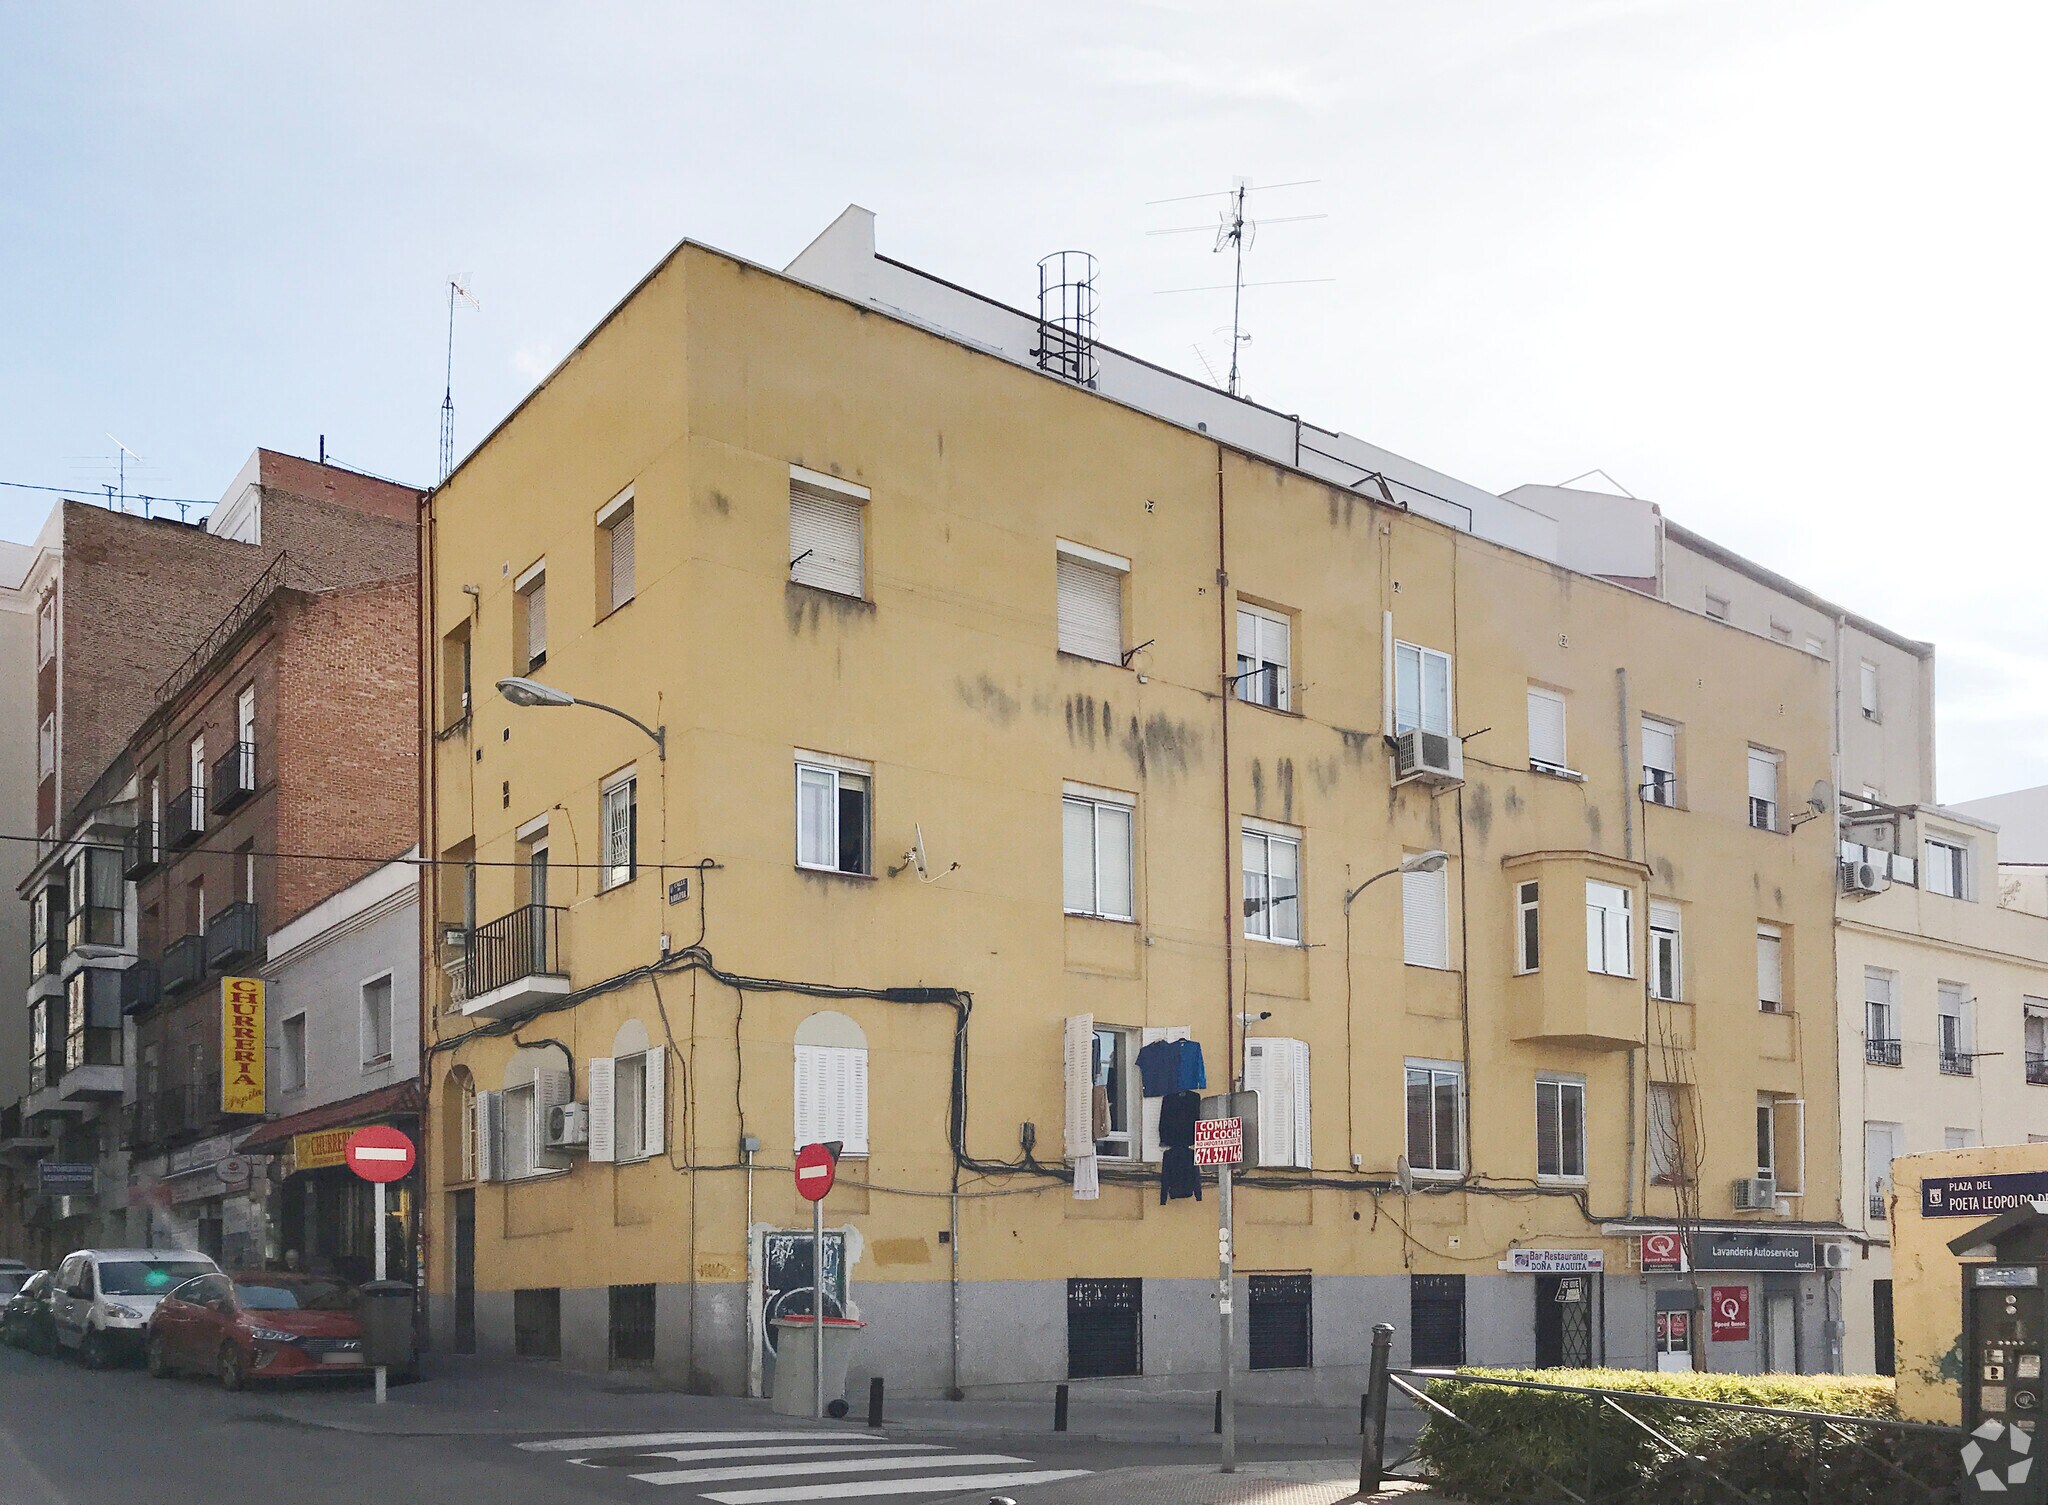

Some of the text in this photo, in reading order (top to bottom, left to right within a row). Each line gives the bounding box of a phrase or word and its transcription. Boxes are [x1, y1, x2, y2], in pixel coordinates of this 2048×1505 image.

[230, 980, 259, 1086] CHURRERIA
[1200, 1118, 1238, 1131] COMPRO
[1197, 1128, 1241, 1140] TU COCHE
[1949, 1181, 1992, 1191] PLAZA DEL
[1949, 1196, 1979, 1211] POETA
[1982, 1194, 2034, 1209] LEOPOLDO
[1530, 1251, 1588, 1260] Bar Restaurante
[1753, 1248, 1799, 1258] Autoservicio
[1531, 1261, 1587, 1271] DOÑA PAQUITA
